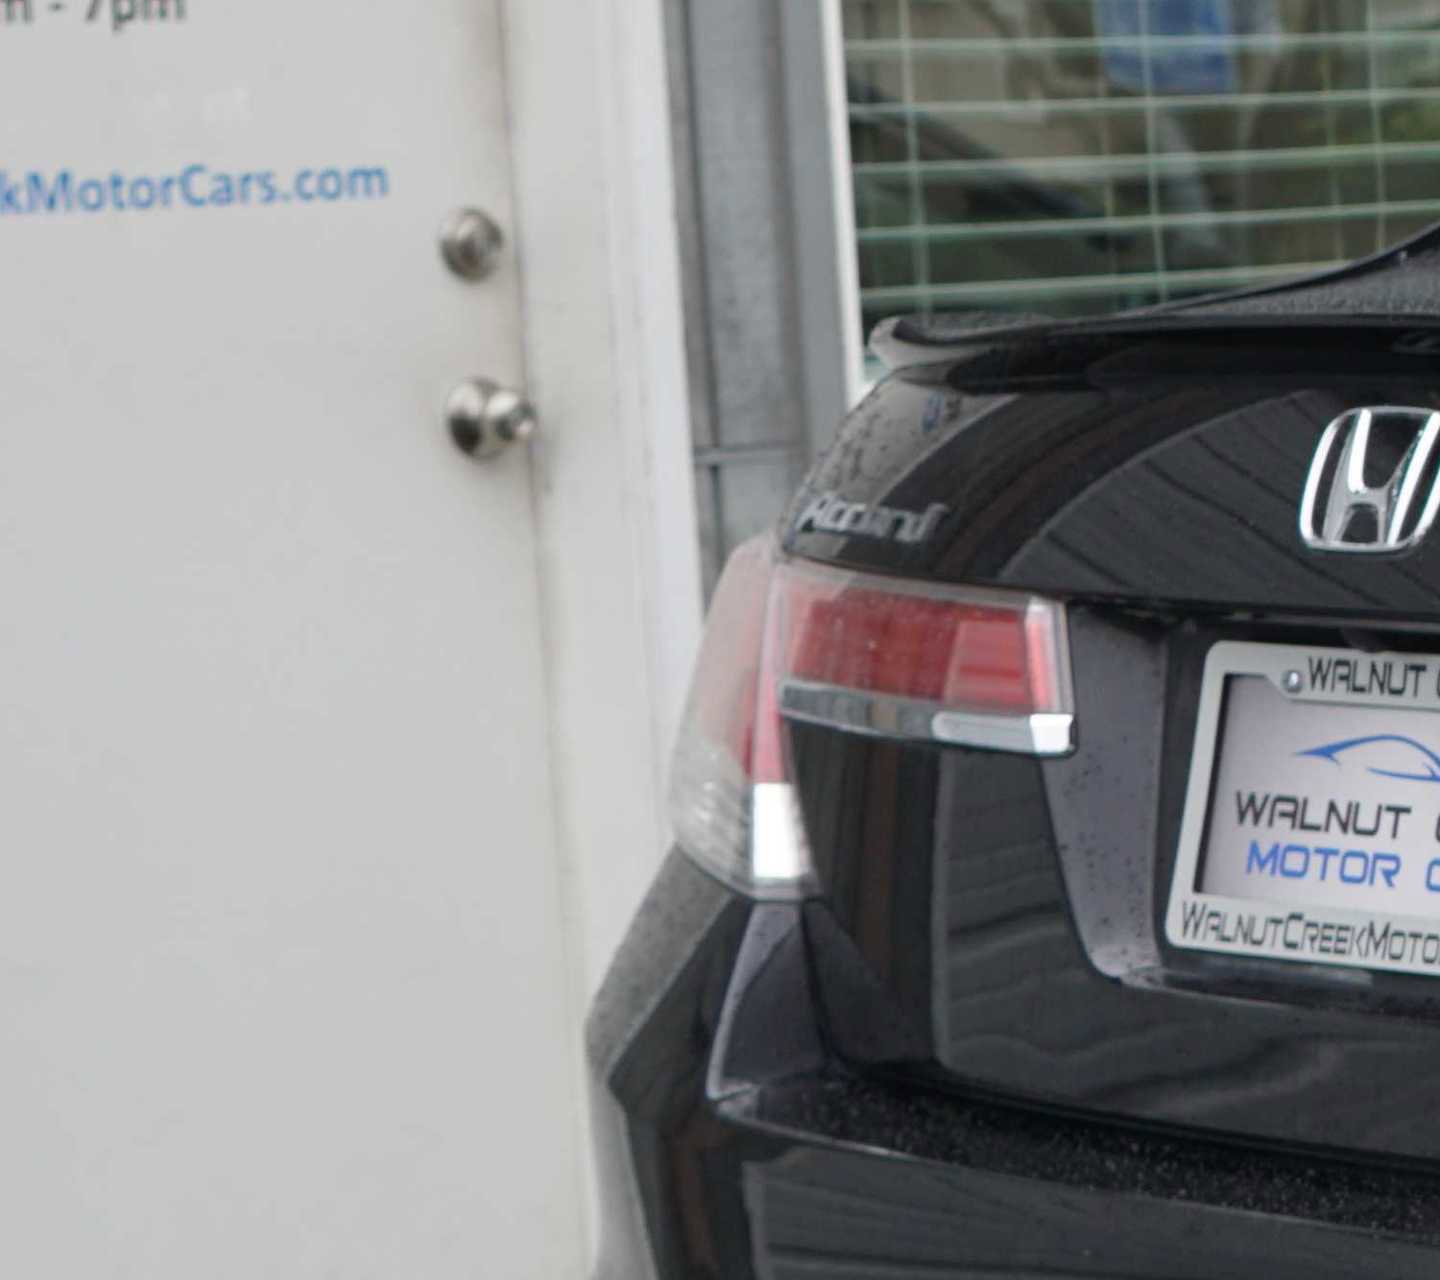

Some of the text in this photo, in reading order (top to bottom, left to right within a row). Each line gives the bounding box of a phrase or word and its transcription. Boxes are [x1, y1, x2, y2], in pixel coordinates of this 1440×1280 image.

[1308, 655, 1427, 698] WALNUT
[1236, 791, 1412, 840] WALNUT
[1247, 840, 1402, 888] MOTOR
